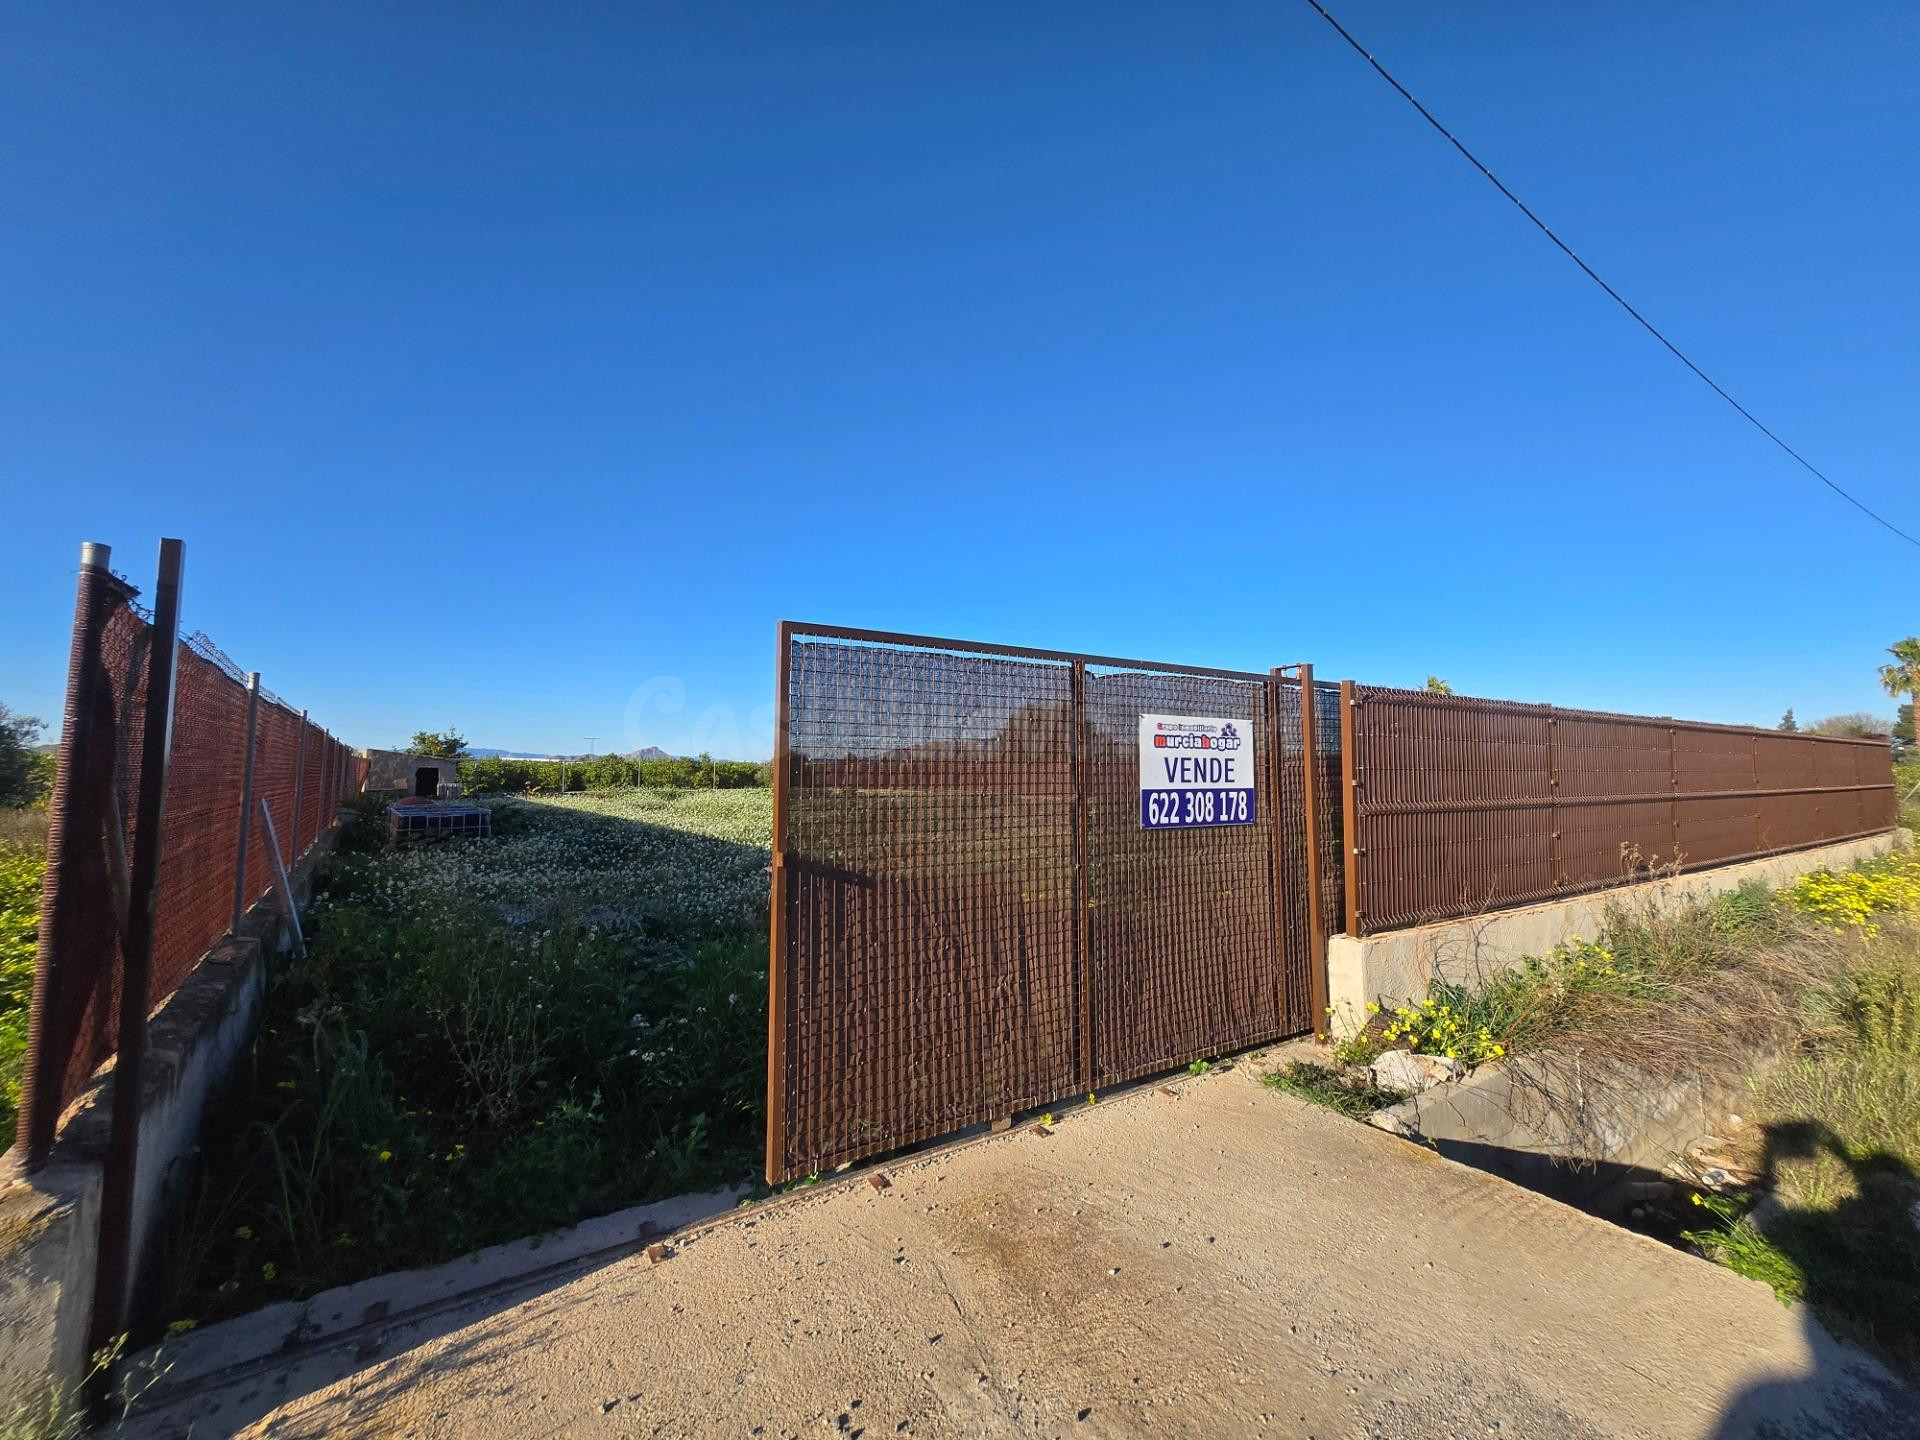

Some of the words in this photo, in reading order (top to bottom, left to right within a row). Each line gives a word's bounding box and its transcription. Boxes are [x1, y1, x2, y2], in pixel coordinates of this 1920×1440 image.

[1164, 757, 1235, 783] VENDE
[1149, 792, 1180, 825] 622
[1185, 791, 1214, 823] 308
[1219, 791, 1248, 821] 178
